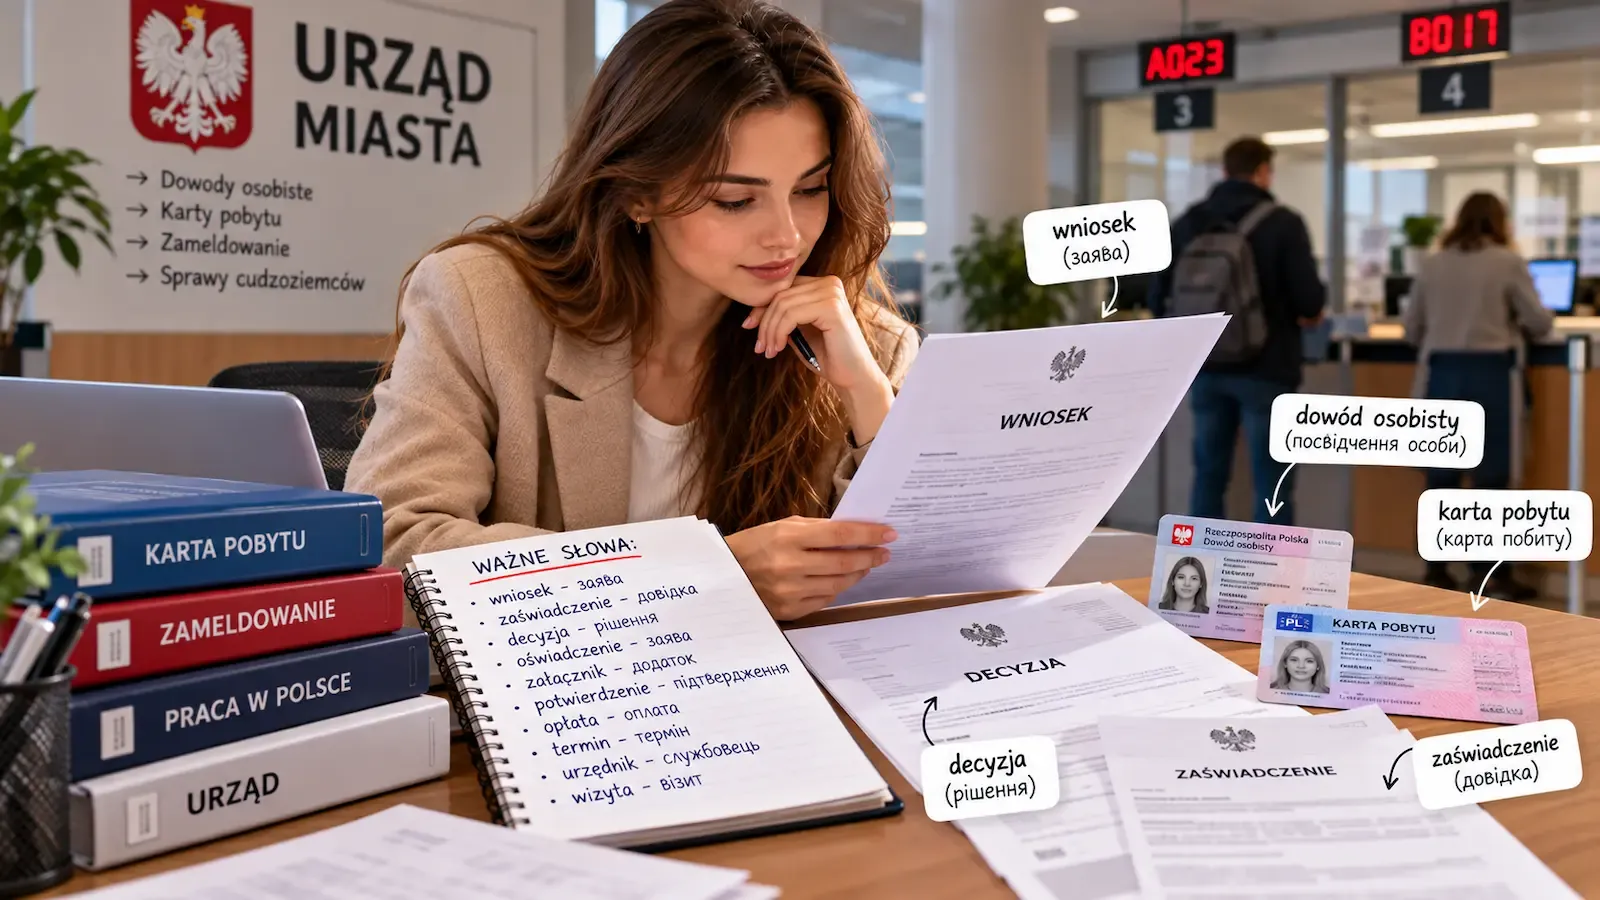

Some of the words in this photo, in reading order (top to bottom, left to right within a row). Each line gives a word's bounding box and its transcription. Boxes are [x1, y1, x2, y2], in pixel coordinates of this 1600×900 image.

[1409, 9, 1498, 55] B017
[296, 22, 491, 114] URZĄD
[1146, 39, 1224, 80] A023
[1442, 73, 1464, 106] 4
[1175, 96, 1192, 126] 3
[296, 101, 481, 167] MIASTA
[161, 170, 235, 200] Dowody
[242, 179, 313, 202] osobiste
[161, 201, 212, 228] Karty
[221, 208, 282, 231] pobytu
[161, 232, 290, 257] Zameldowanie
[161, 265, 228, 292] Sprawy
[236, 270, 365, 292] cudzoziemców
[1001, 406, 1093, 430] WNIOSEK
[146, 538, 216, 565] KARTA
[225, 530, 305, 557] POBYTU
[1203, 537, 1234, 547] Dowód
[1237, 542, 1274, 553] osobisty
[1279, 534, 1309, 544] Polska
[472, 549, 549, 574] WAŻNE
[561, 538, 637, 560] SŁOWA:
[489, 583, 553, 605] wniosek
[577, 575, 624, 590] заява
[498, 594, 612, 626] zaświadczenie
[638, 585, 698, 605] довідка
[160, 598, 336, 645] ZAMELDOWANIE
[508, 626, 570, 647] decyzja
[594, 613, 659, 637] рішення
[1286, 618, 1303, 629] PL
[1332, 619, 1377, 631] KARTA
[1381, 622, 1435, 635] POBYTU
[517, 640, 623, 669] oświadczenie
[646, 632, 693, 647] заява
[632, 654, 697, 678] додаток
[964, 658, 1066, 683] DECYZJA
[166, 697, 240, 732] PRACA
[248, 690, 268, 712] W
[277, 672, 351, 706] POLSCE
[535, 683, 652, 715] potwierdzenie
[673, 663, 790, 689] підтвердження
[544, 714, 599, 737] opłata
[624, 704, 680, 721] оплата
[552, 736, 611, 756] termin
[634, 724, 690, 746] термін
[562, 755, 639, 780] urzędnik
[663, 741, 760, 767] службовець
[1175, 763, 1337, 779] ZAŚWIADCZENIE
[188, 772, 279, 815] URZĄD
[572, 783, 634, 805] wizyta
[660, 774, 702, 791] візит
